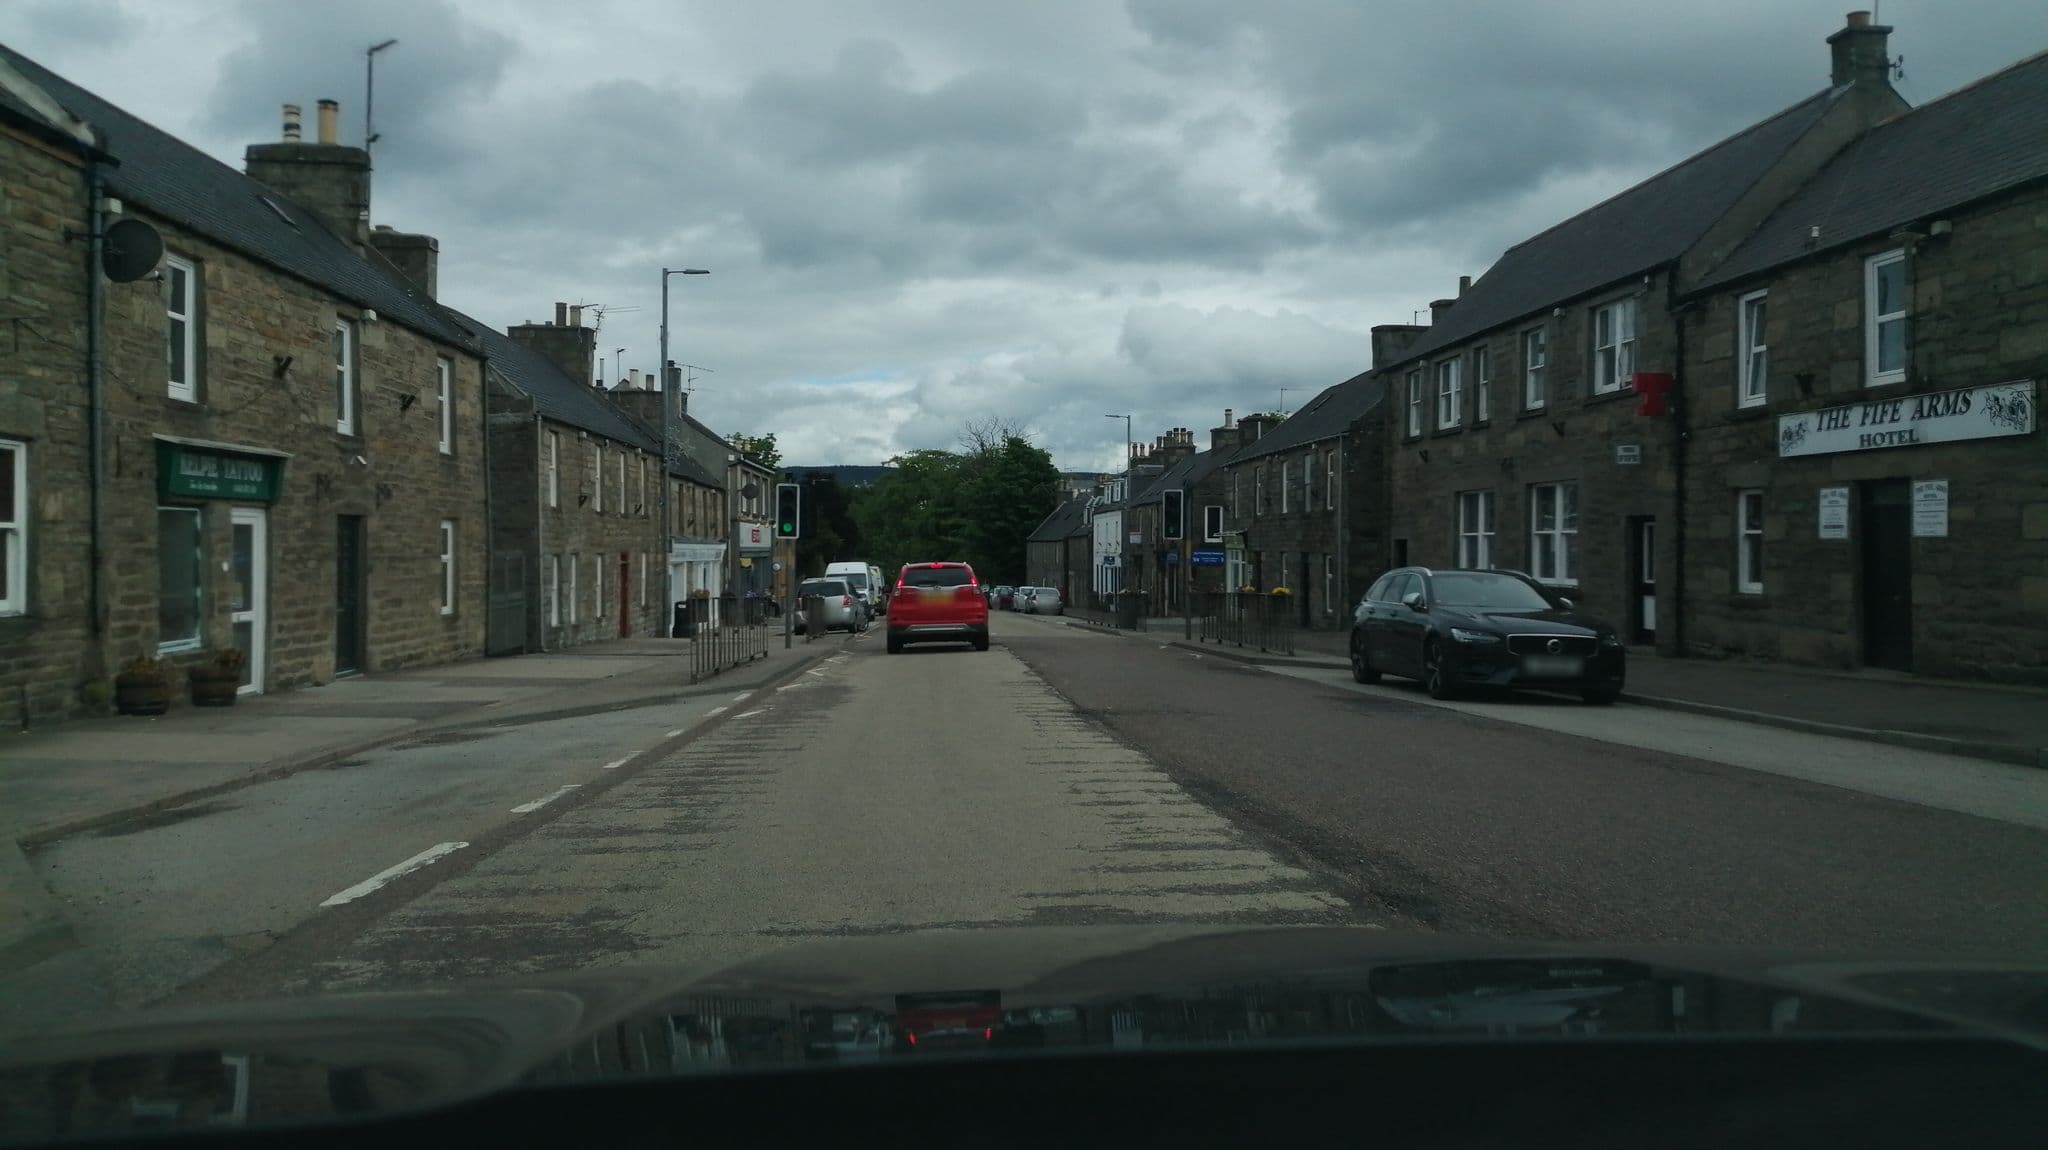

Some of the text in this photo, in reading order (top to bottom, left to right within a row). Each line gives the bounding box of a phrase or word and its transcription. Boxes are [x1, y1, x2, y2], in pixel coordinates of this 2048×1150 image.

[1816, 390, 1973, 432] THE FIFE ARMS
[1860, 429, 1920, 448] HOTEL
[224, 457, 263, 482] TATTOO
